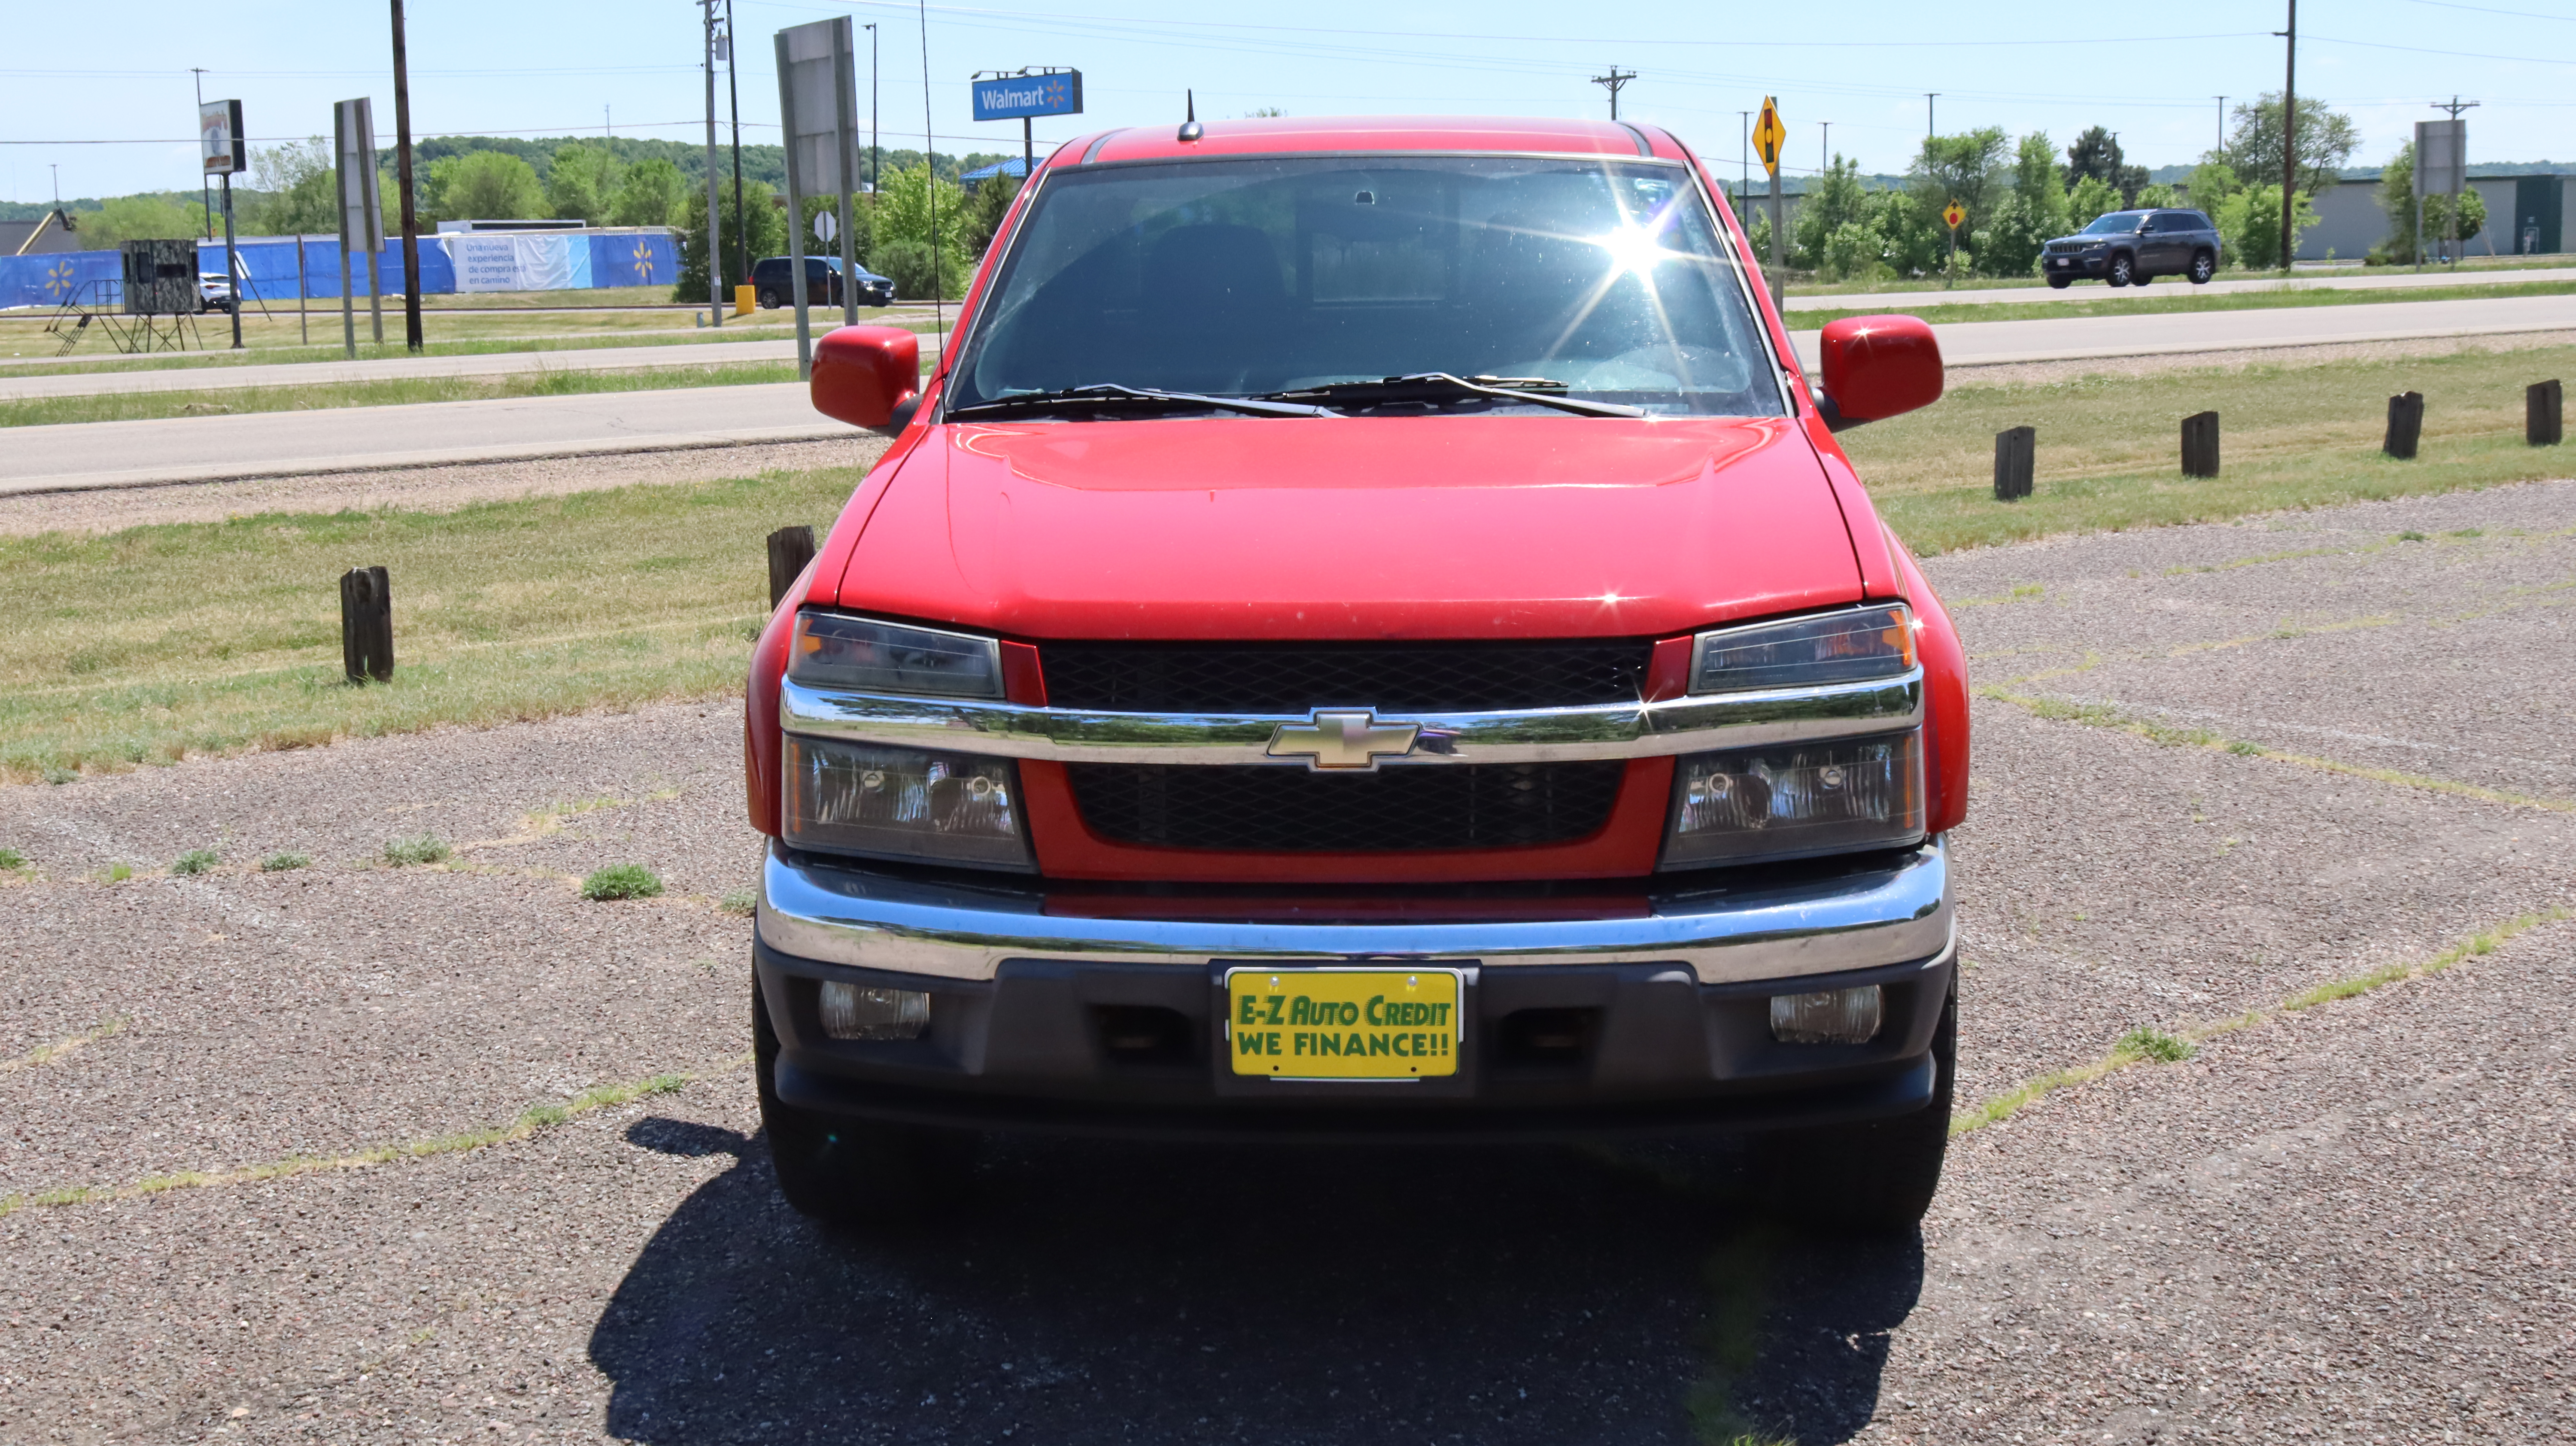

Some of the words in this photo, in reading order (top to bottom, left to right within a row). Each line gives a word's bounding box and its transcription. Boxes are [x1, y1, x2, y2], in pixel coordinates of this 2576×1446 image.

[982, 85, 1044, 110] Walmart
[468, 254, 514, 263] experiencia
[480, 266, 511, 274] compra
[1236, 995, 1286, 1025] E-Z
[1238, 1032, 1282, 1055] WE
[1294, 1033, 1449, 1057] FINANCE!!
